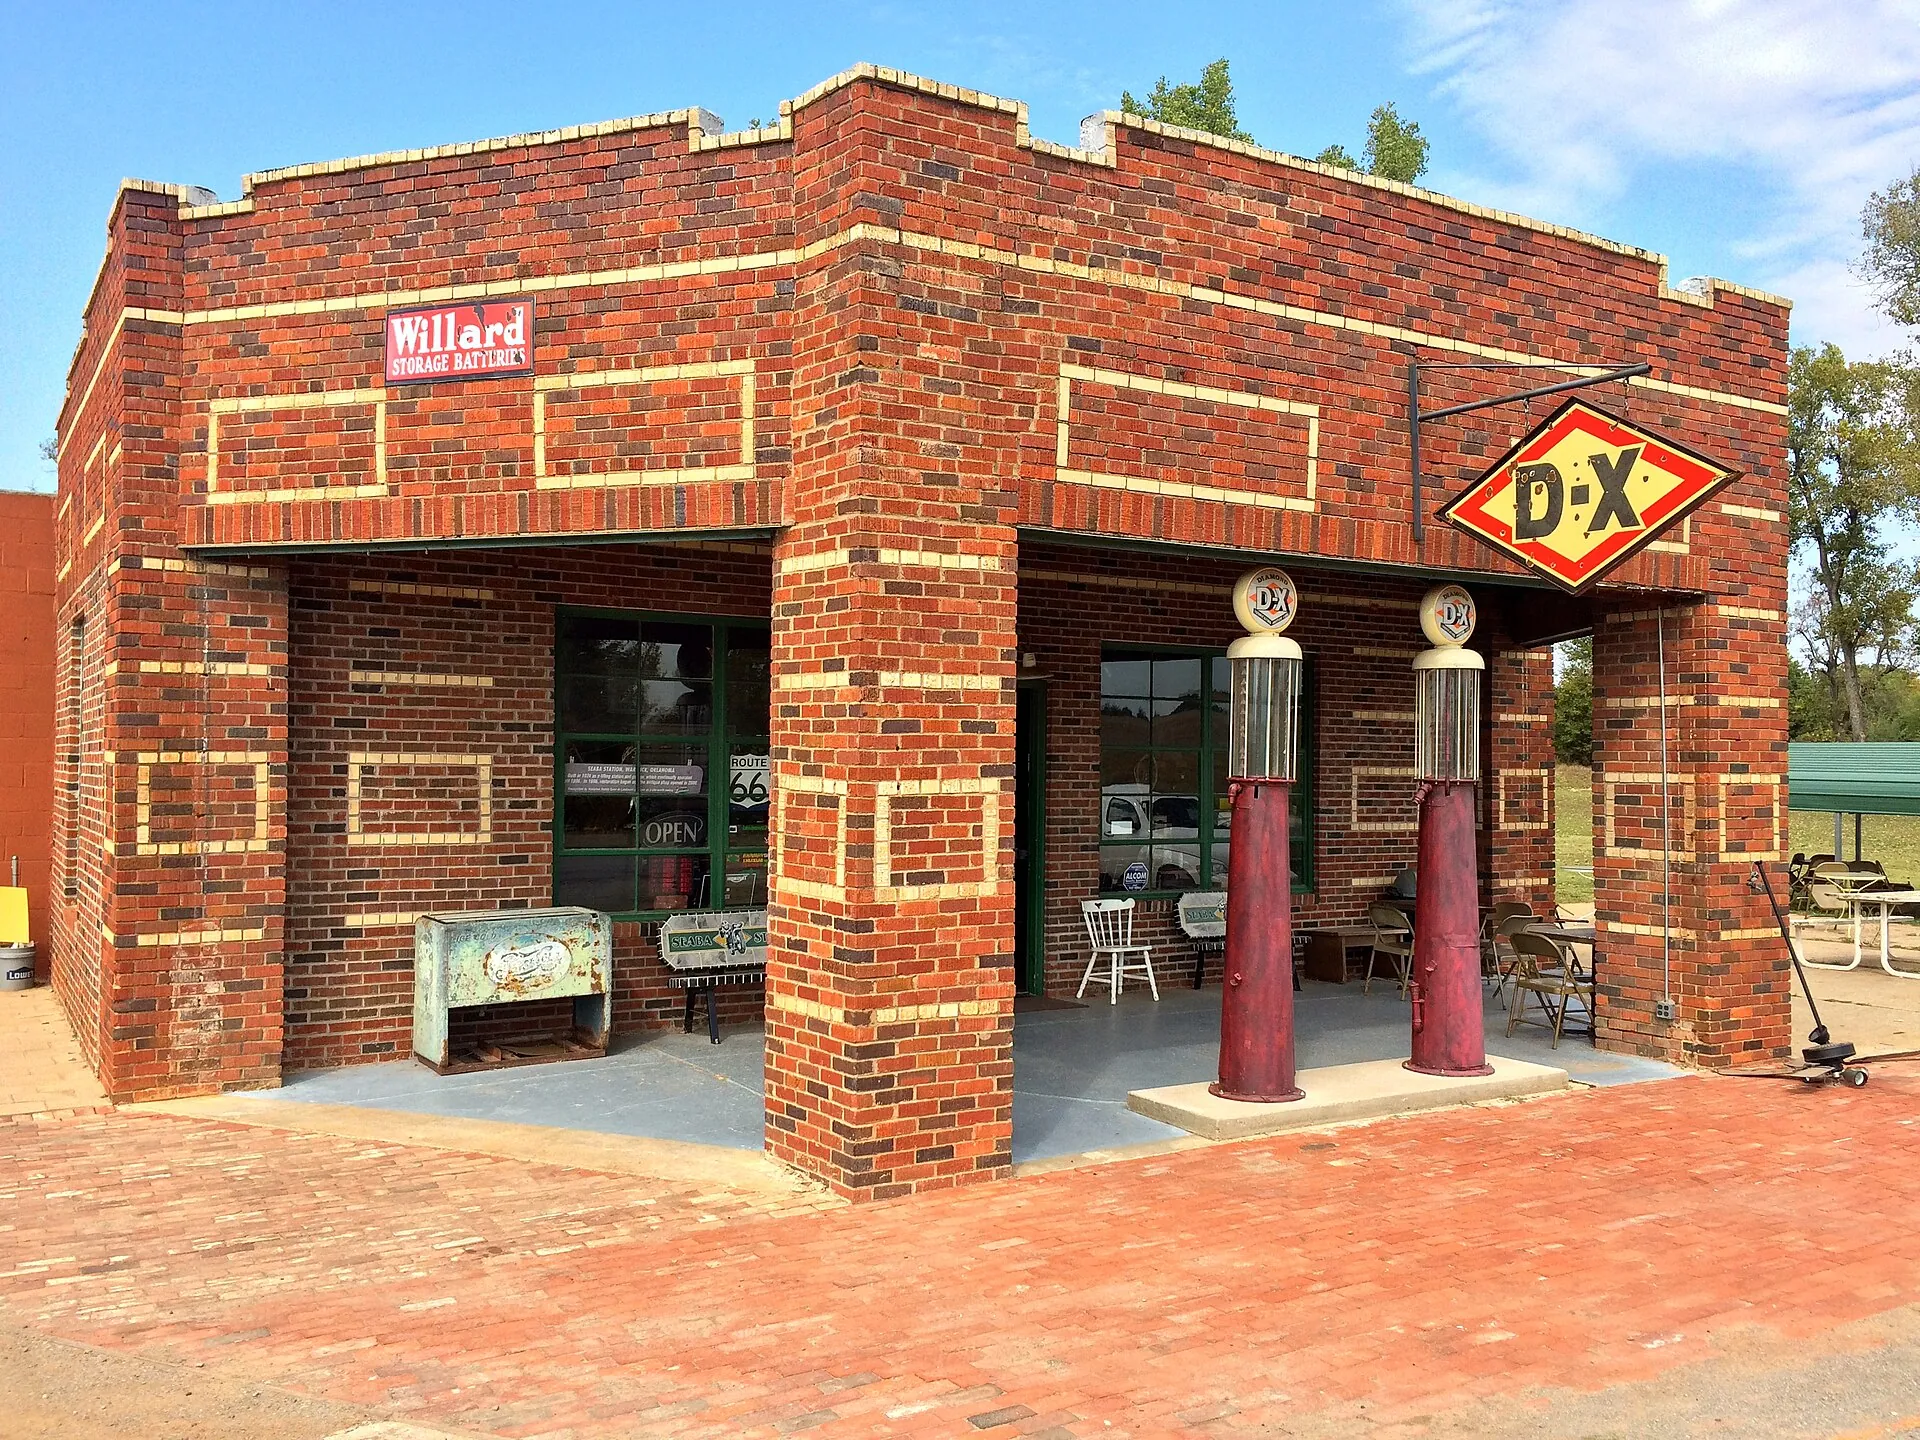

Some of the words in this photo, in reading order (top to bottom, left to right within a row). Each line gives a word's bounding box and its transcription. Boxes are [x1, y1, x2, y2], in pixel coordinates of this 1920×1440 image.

[391, 306, 526, 355] Willard
[392, 353, 449, 376] STORAGE
[453, 348, 526, 371] BATTERIES
[1516, 447, 1641, 540] D-X
[1257, 574, 1289, 586] DIAMOND
[1256, 586, 1289, 612] D-X
[1443, 603, 1470, 626] D-X
[731, 758, 767, 767] ROUTE
[730, 772, 767, 802] 66
[645, 822, 697, 844] OPEN
[1125, 872, 1147, 880] ALCOM
[671, 935, 713, 949] SEABA
